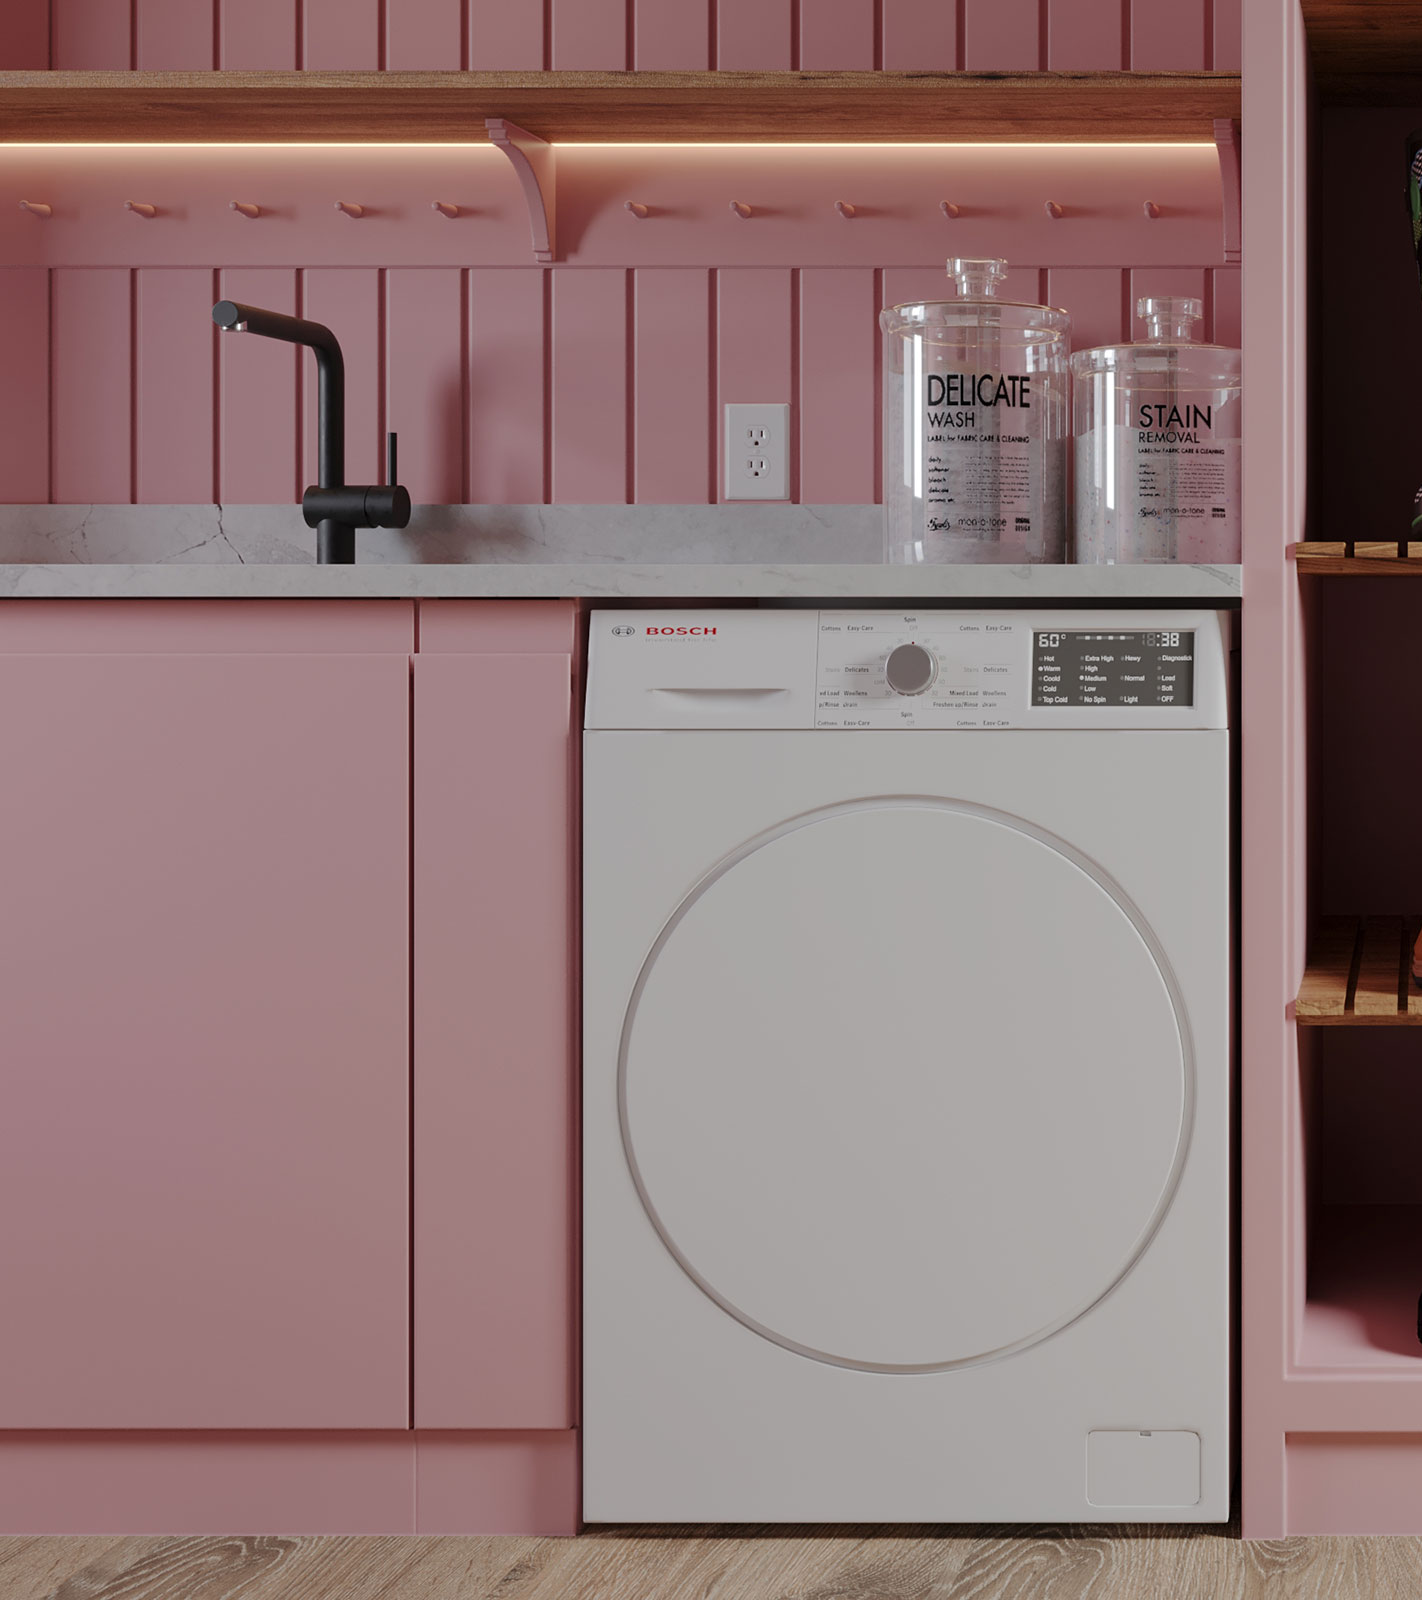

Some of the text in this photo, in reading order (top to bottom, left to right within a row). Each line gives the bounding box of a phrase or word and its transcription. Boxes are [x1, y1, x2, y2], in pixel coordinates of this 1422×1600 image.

[927, 373, 1031, 408] DELICATE
[928, 411, 975, 429] WASH
[1138, 405, 1212, 430] STAIN
[927, 435, 946, 443] LABEL
[979, 435, 994, 443] CARE
[1001, 435, 1030, 444] CLEANING
[1138, 431, 1200, 444] REMOVAL
[646, 627, 717, 635] BOSCH
[1101, 655, 1114, 663] High
[1084, 665, 1098, 673] High
[1123, 695, 1138, 703] Light
